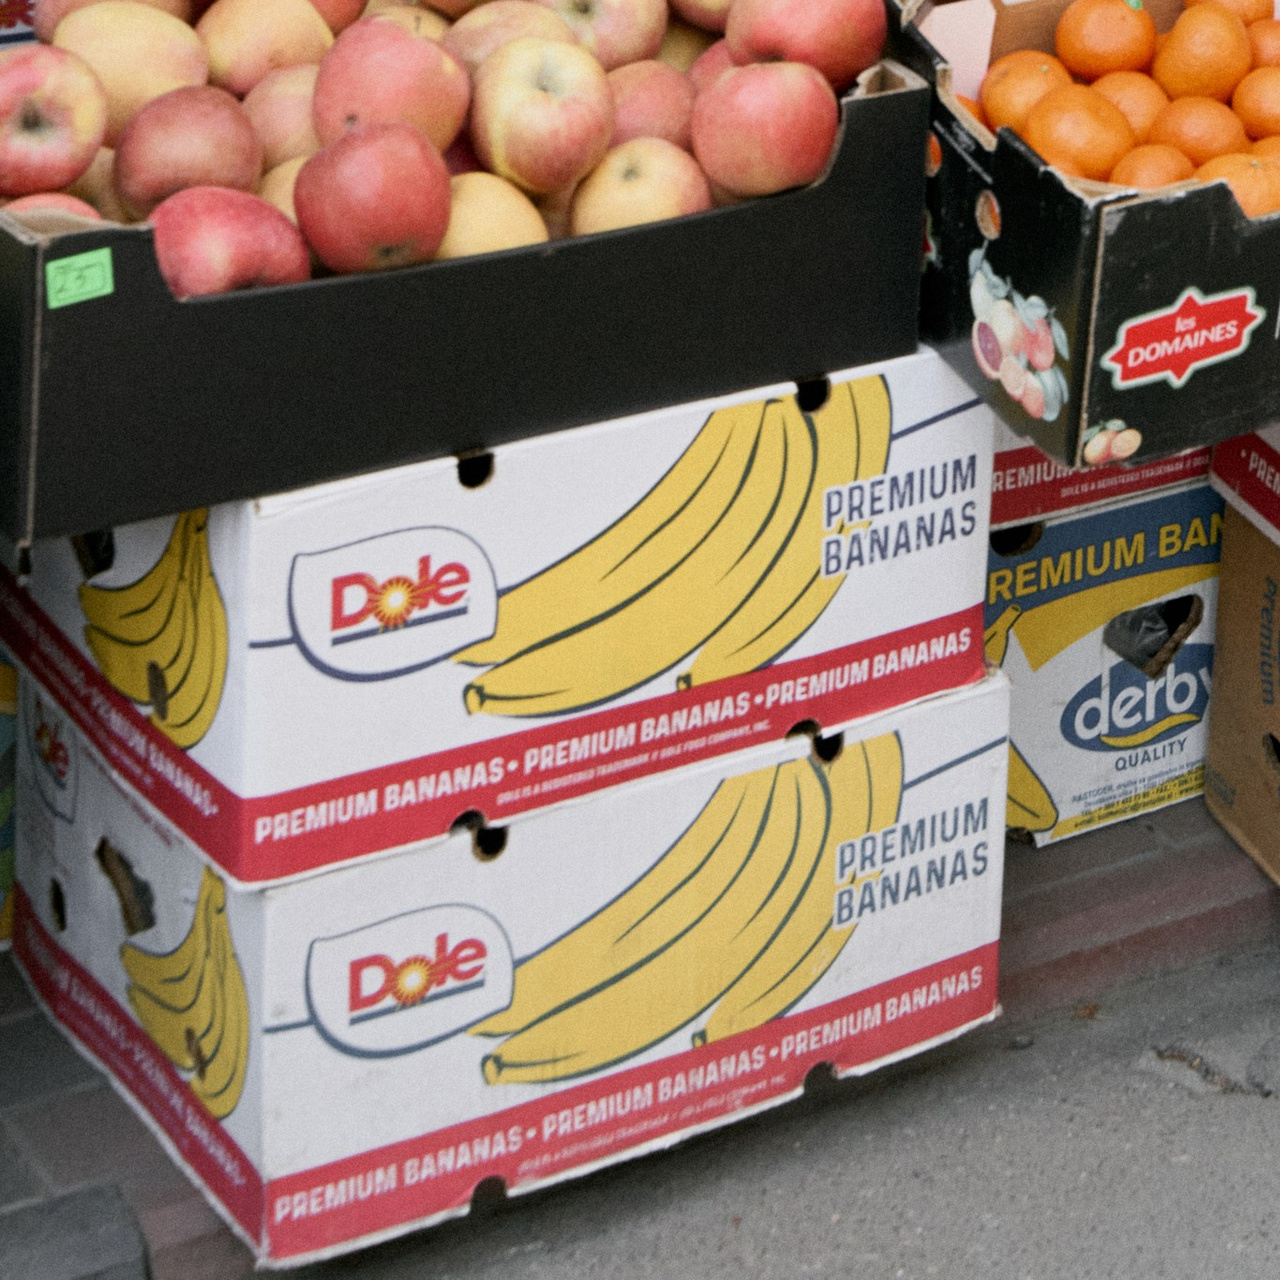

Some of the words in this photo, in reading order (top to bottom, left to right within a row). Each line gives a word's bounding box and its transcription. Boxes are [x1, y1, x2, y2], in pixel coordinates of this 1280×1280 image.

[1128, 318, 1240, 367] DOMAINES
[1174, 315, 1197, 333] les
[825, 454, 977, 528] PREMIUM
[824, 501, 977, 577] BANANAS
[988, 531, 1146, 606] REMIUM
[331, 554, 471, 630] Dole
[255, 790, 378, 843] PREMIUM
[384, 757, 505, 812] BANANAS
[524, 723, 636, 774] PREMIUM
[640, 692, 750, 742] BANANAS
[765, 660, 869, 709] PREMIUM
[873, 627, 972, 679] BANANAS
[1115, 737, 1186, 771] QUALITY
[838, 796, 989, 880] PREMIUM
[836, 842, 989, 926] BANANAS
[348, 932, 488, 1014] Dole
[274, 1163, 398, 1225] PREMIUM
[404, 1124, 524, 1187] BANANAS
[542, 1081, 654, 1142] PREMIUM
[658, 1045, 766, 1103] BANANAS
[781, 1008, 882, 1060] PREMIUM
[886, 965, 984, 1026] BANANAS
